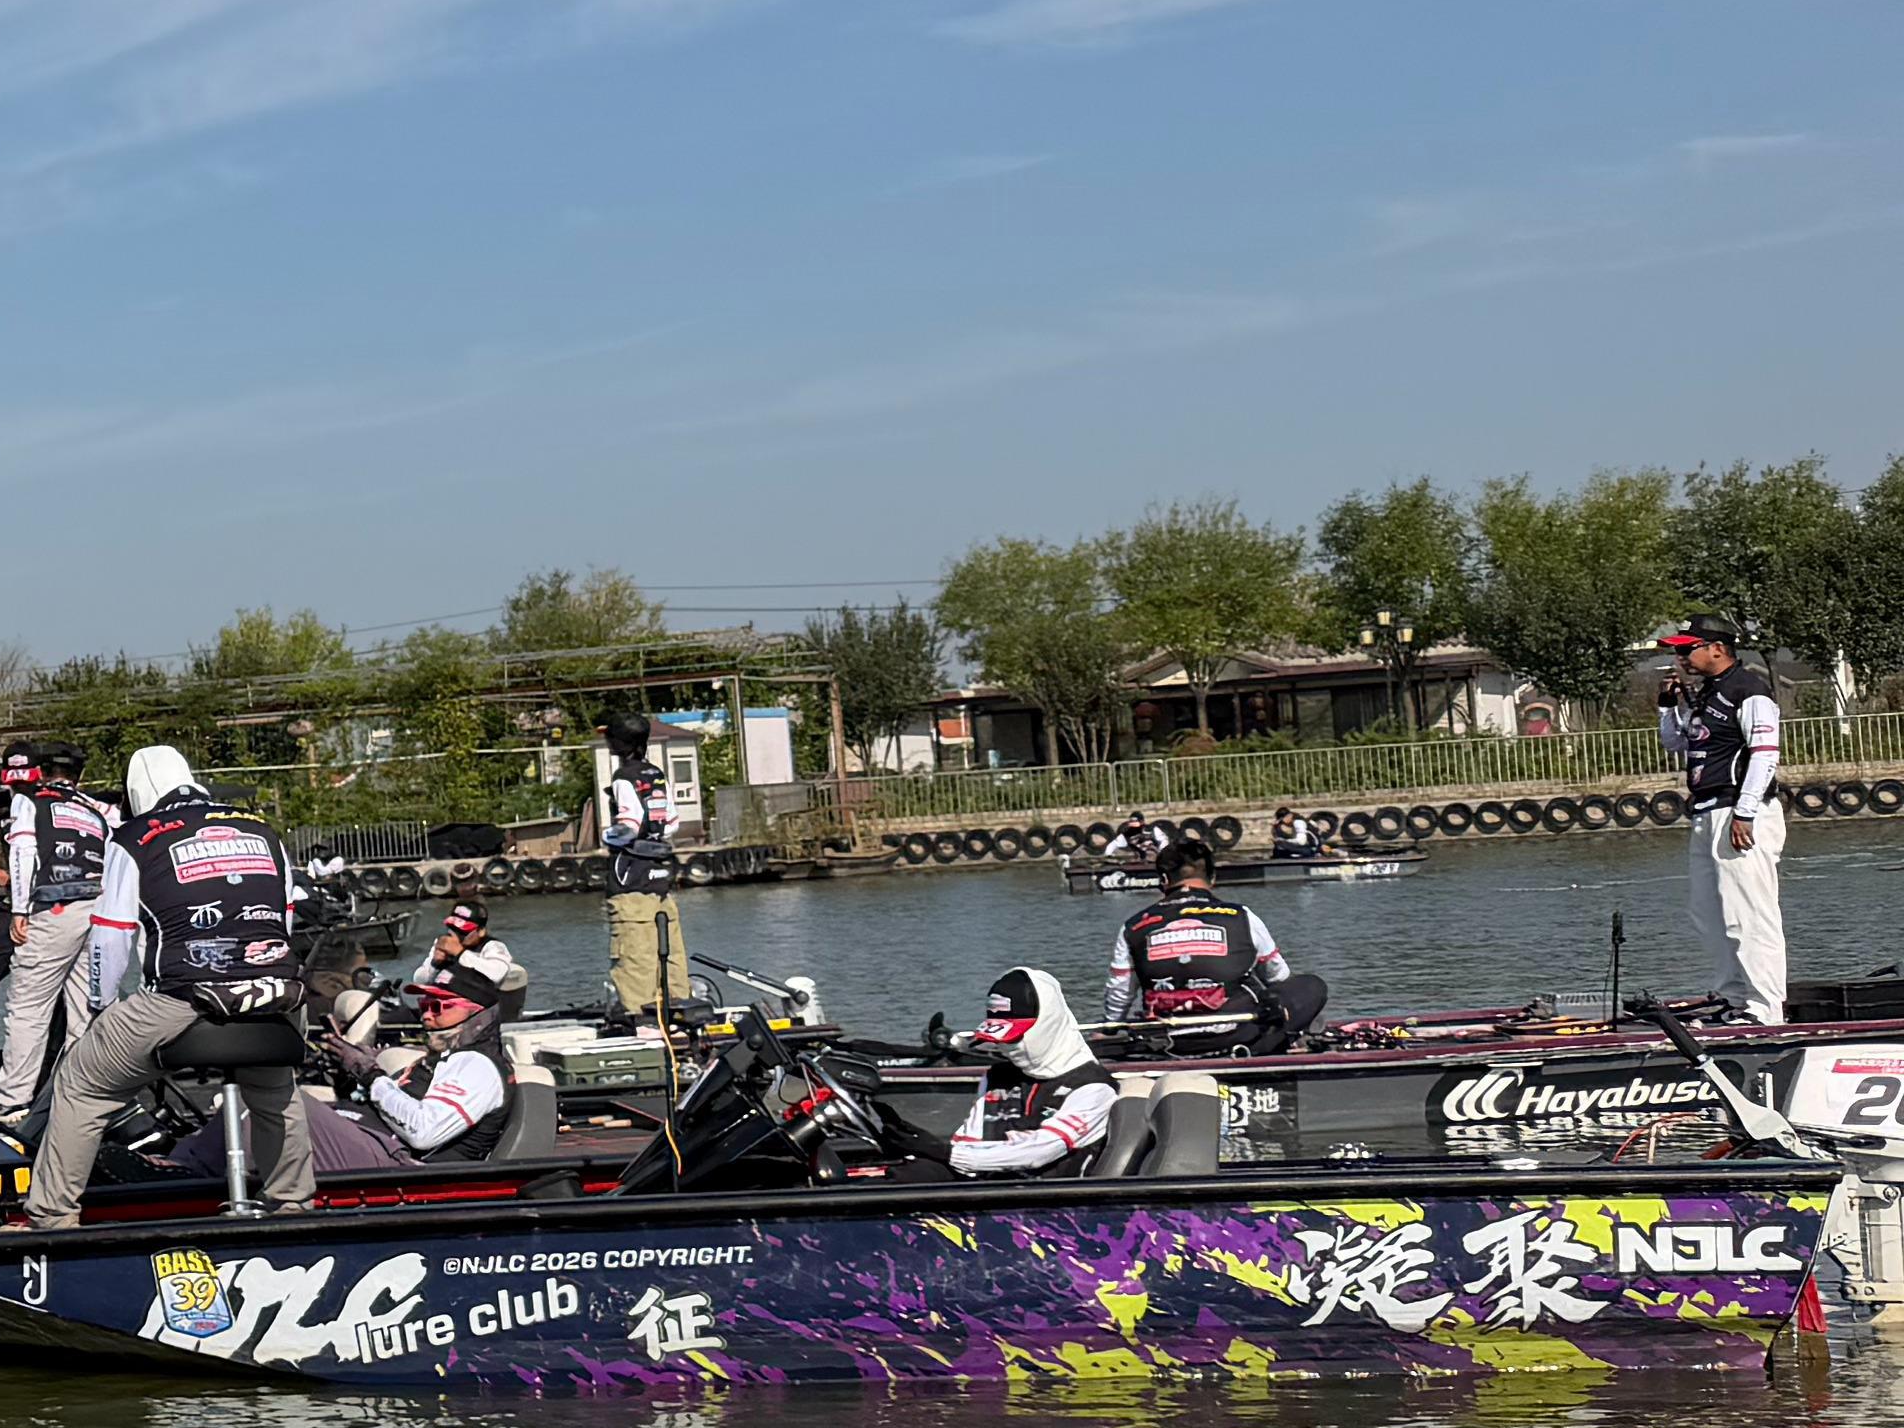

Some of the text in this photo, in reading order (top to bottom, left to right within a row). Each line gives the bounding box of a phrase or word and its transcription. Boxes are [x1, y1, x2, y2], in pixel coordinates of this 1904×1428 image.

[1842, 1076, 1904, 1126] 2
[530, 1251, 598, 1272] 2026
[170, 1276, 218, 1312] 39
[355, 1277, 580, 1364] lure club
[627, 1285, 728, 1362] 征
